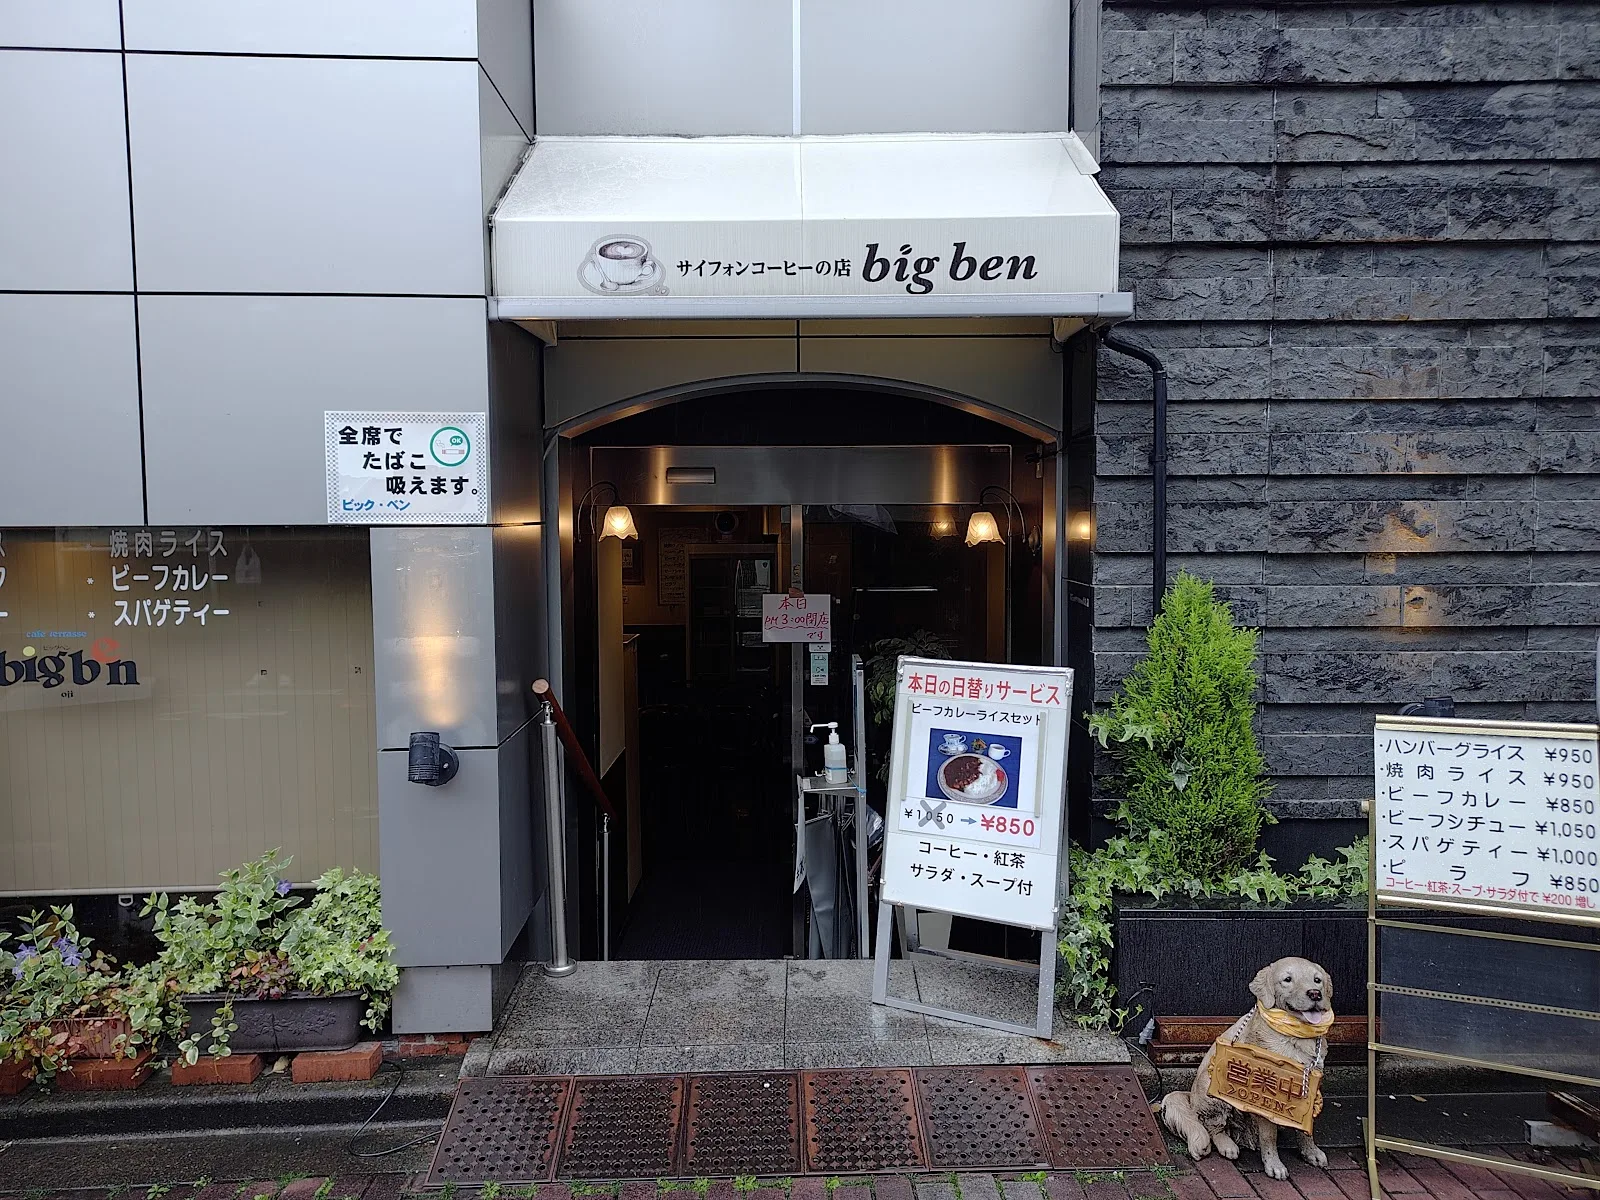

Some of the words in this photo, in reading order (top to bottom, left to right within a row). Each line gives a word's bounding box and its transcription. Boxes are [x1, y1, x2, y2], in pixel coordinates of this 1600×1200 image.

[676, 259, 851, 277] サイフォンコーヒーの店
[862, 243, 940, 294] big
[949, 241, 1038, 281] ben
[338, 425, 403, 446] 全席で
[362, 451, 426, 470] たばこ
[386, 476, 478, 495] 吸えます。
[109, 529, 228, 558] 焼肉ライス
[112, 564, 229, 592] ビーフカレー
[114, 598, 230, 627] スパゲティー
[778, 596, 807, 610] 本日
[61, 690, 74, 698] oji
[907, 672, 1061, 705] 本日の日替りサービス
[911, 703, 1041, 725] ビーフカレーライスセット
[1385, 739, 1525, 761] ハンバーグライス
[1544, 747, 1593, 764] ¥950
[1386, 762, 1526, 786] 焼肉ライス
[1543, 771, 1594, 789] ¥950
[1388, 786, 1526, 808] ビーフカレー
[1546, 797, 1595, 815] ¥850
[981, 813, 1035, 837] ¥850
[1388, 809, 1526, 833] ビーフシチュー
[1535, 820, 1596, 839] ¥1,050
[918, 841, 1026, 869] コーヒー・紅茶
[1388, 834, 1528, 859] スパゲティー
[1537, 846, 1598, 866] ¥1,000
[910, 863, 1034, 896] サラダ・スープ付
[1549, 874, 1600, 893] ¥850
[1542, 893, 1572, 906] ¥200
[1226, 1057, 1304, 1102] 営業中
[1238, 1086, 1287, 1113] OPEN
